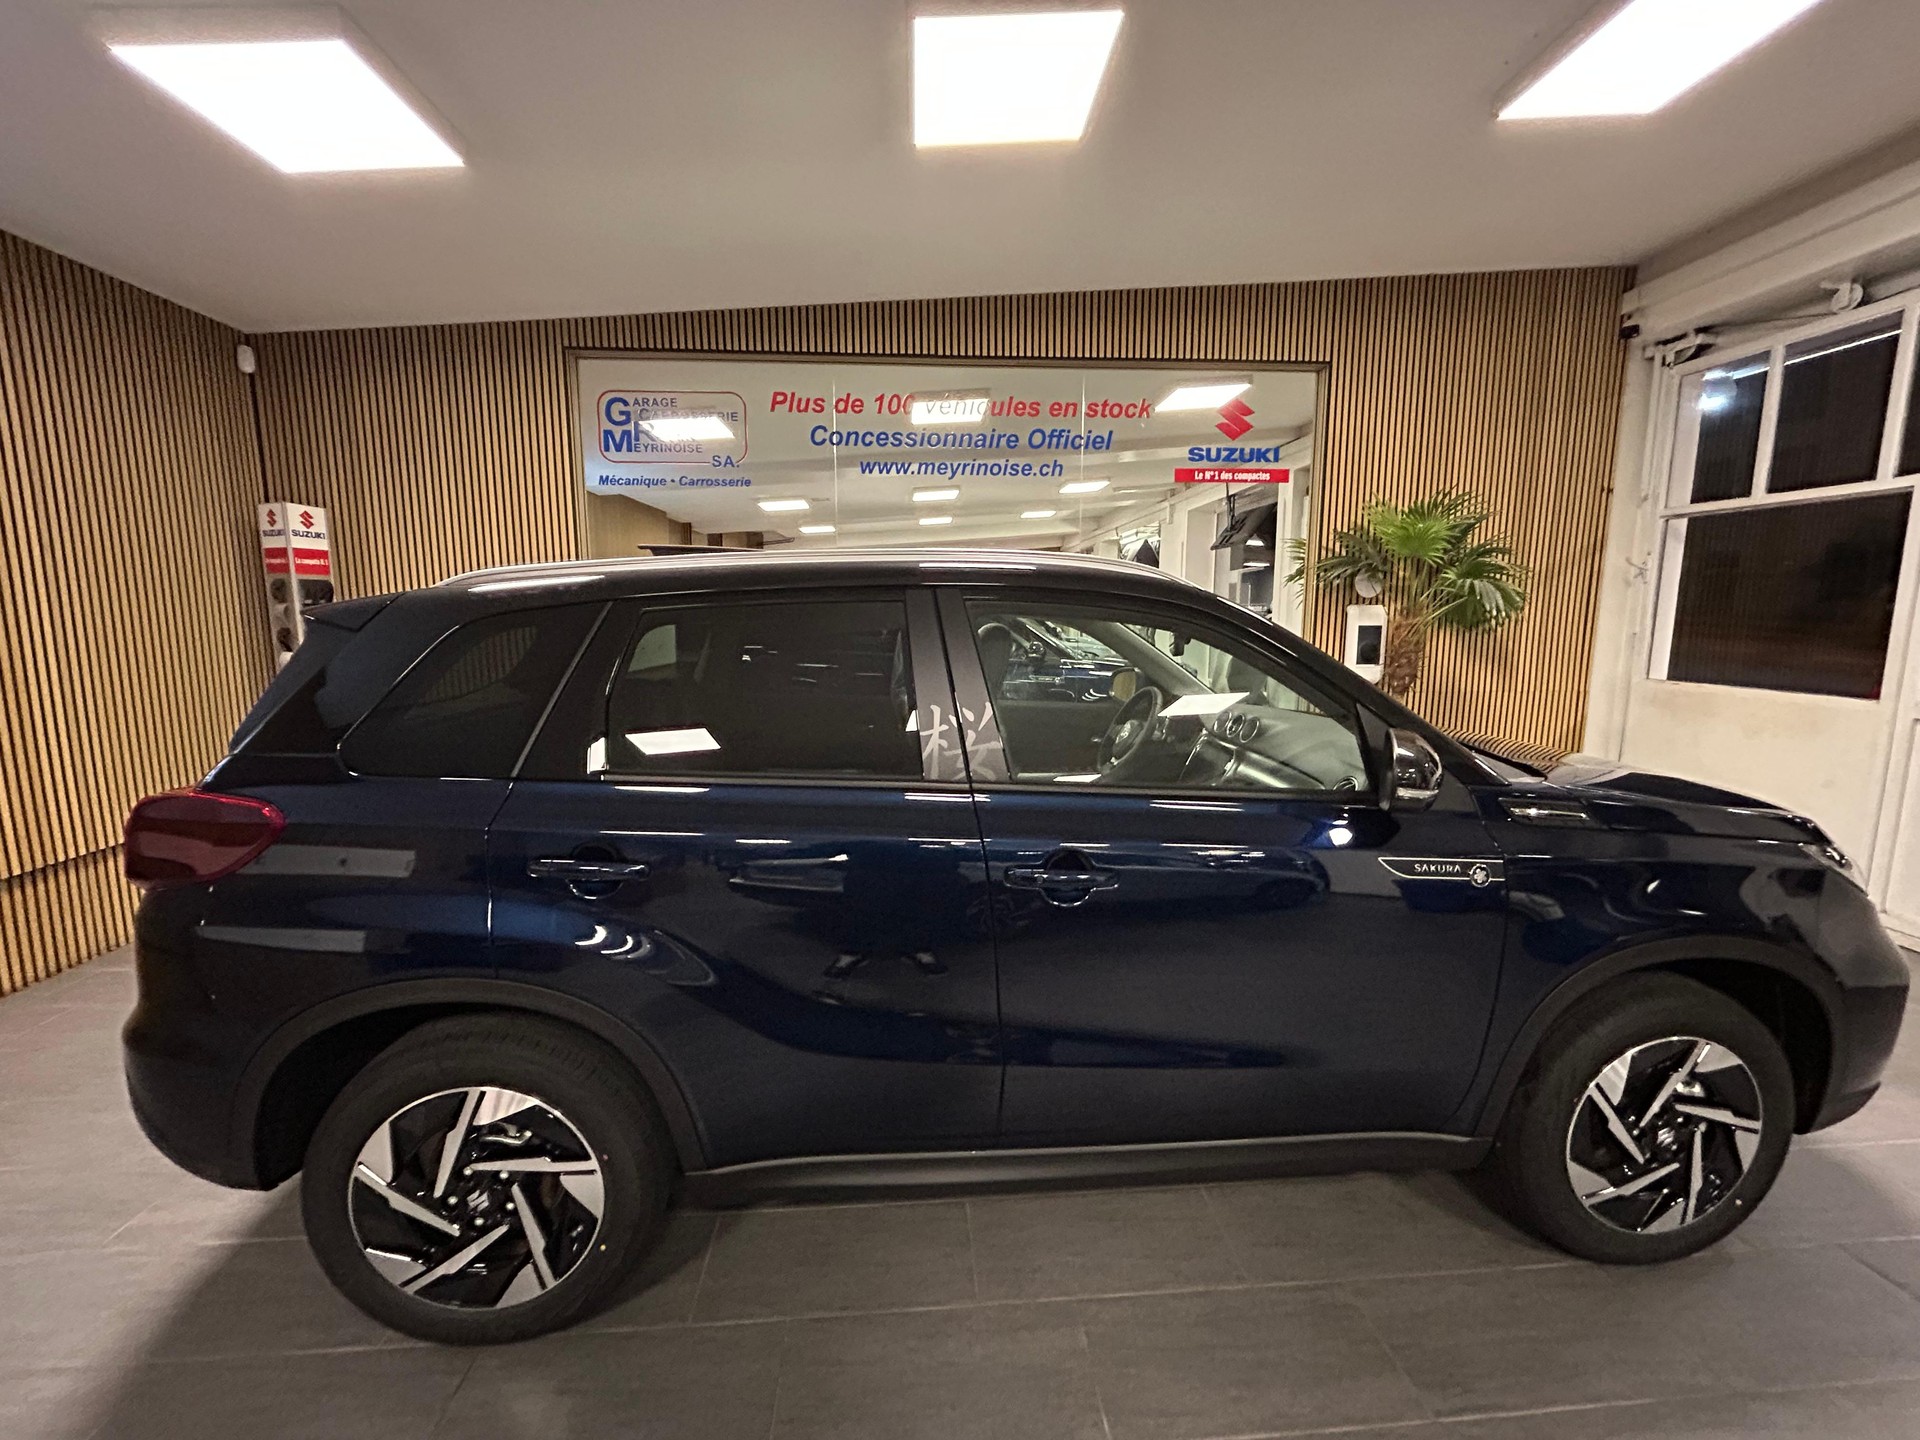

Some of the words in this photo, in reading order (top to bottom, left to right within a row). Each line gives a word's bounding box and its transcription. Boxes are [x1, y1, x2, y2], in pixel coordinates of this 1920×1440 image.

[769, 391, 826, 413] Plus
[834, 393, 865, 414] de
[874, 393, 916, 415] 100
[1049, 399, 1078, 418] en
[1085, 398, 1152, 418] stock
[810, 425, 1020, 449] Concessionnaire
[1028, 428, 1113, 450] Officiel
[1188, 446, 1280, 463] SUZUKI
[860, 459, 1063, 480] www.meyrinoise.ch
[1194, 471, 1204, 480] Le
[1220, 471, 1233, 480] des
[1233, 471, 1270, 482] compactes
[599, 474, 667, 488] Mécanique
[678, 475, 751, 487] Carrosserie
[291, 529, 326, 539] SUZUKI
[1414, 863, 1461, 873] SAKURA
